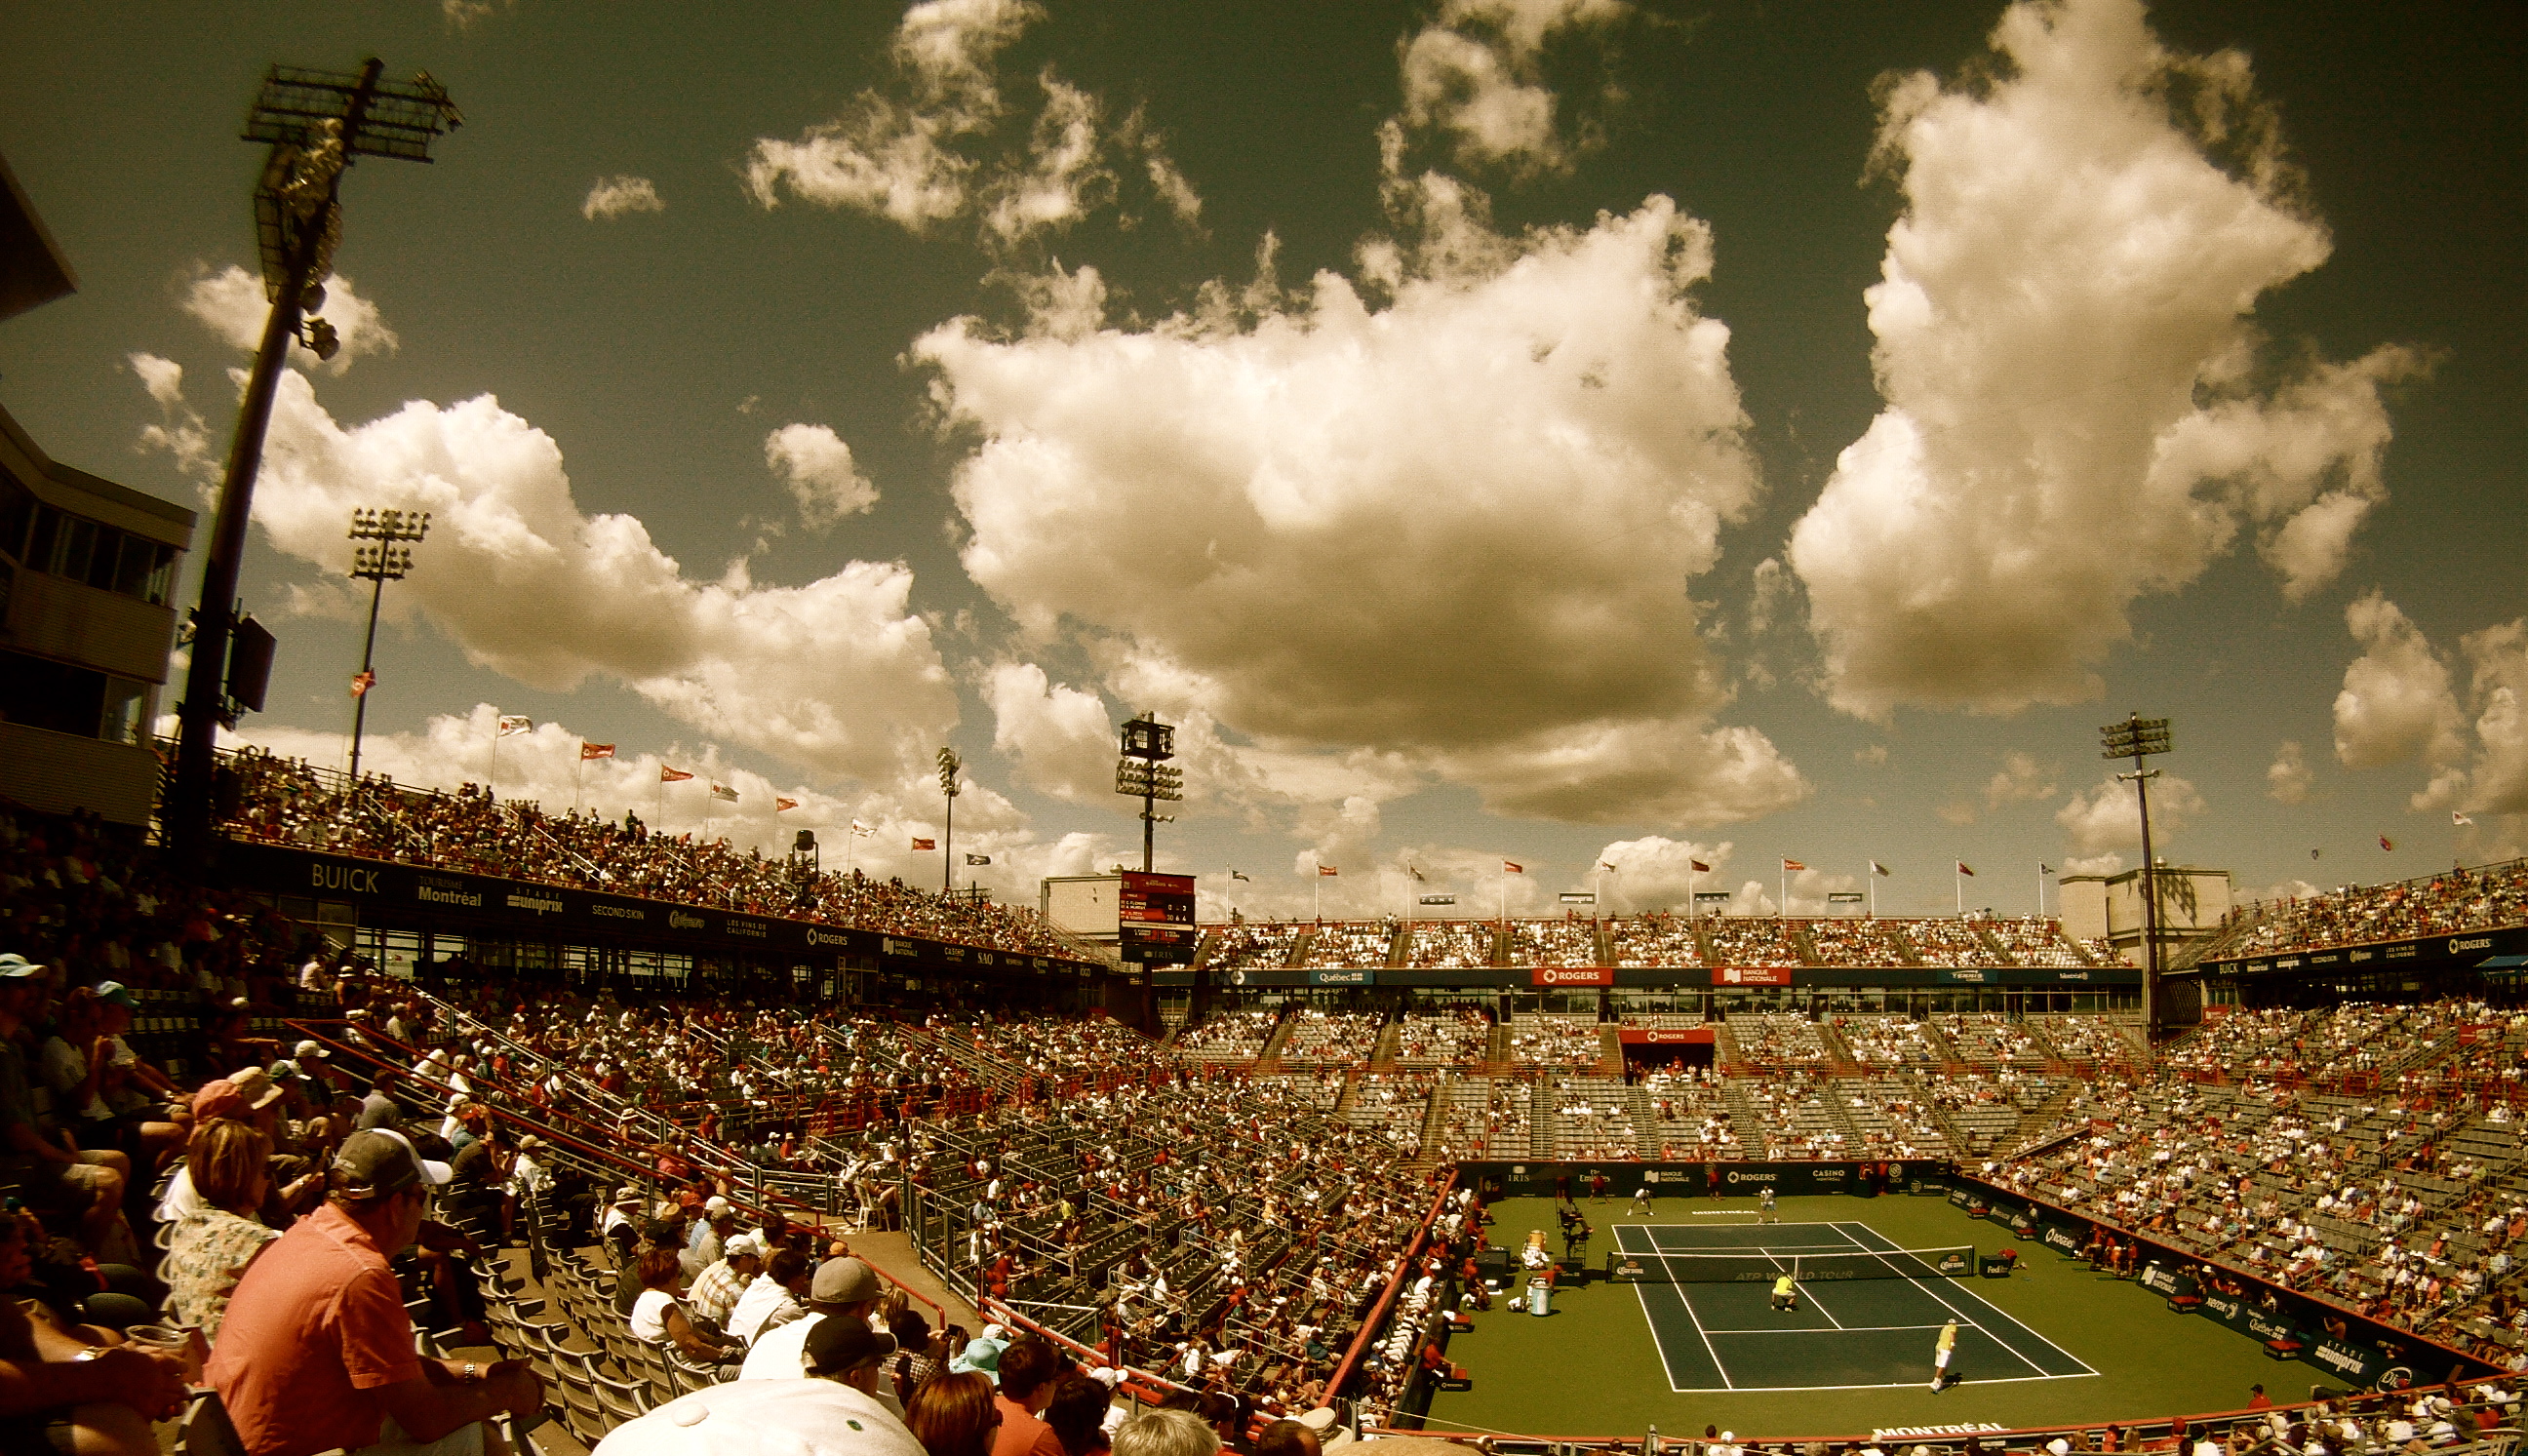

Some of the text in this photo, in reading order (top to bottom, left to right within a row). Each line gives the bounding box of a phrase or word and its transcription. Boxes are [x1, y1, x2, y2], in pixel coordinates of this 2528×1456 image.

[312, 863, 379, 893] BUICK
[419, 876, 463, 889] TOURISME
[418, 885, 482, 907] Montréal
[519, 895, 563, 916] uniprix
[818, 933, 849, 946] ROGERS
[2459, 938, 2492, 950] ROGERS
[977, 952, 994, 966] SAQ
[1154, 951, 1173, 960] IRIS
[2219, 963, 2238, 974] BUICK
[1320, 972, 1351, 983] Québec
[1558, 971, 1600, 980] ROGERS
[1617, 1266, 1644, 1277] Corona
[1940, 1261, 1965, 1271] Corona
[1736, 1272, 1762, 1280] ATP
[1819, 1270, 1853, 1279] TOUR
[2249, 1318, 2274, 1336] Québec
[2324, 1349, 2365, 1375] uniprix
[1873, 1422, 2011, 1436] MONTRÉAL
